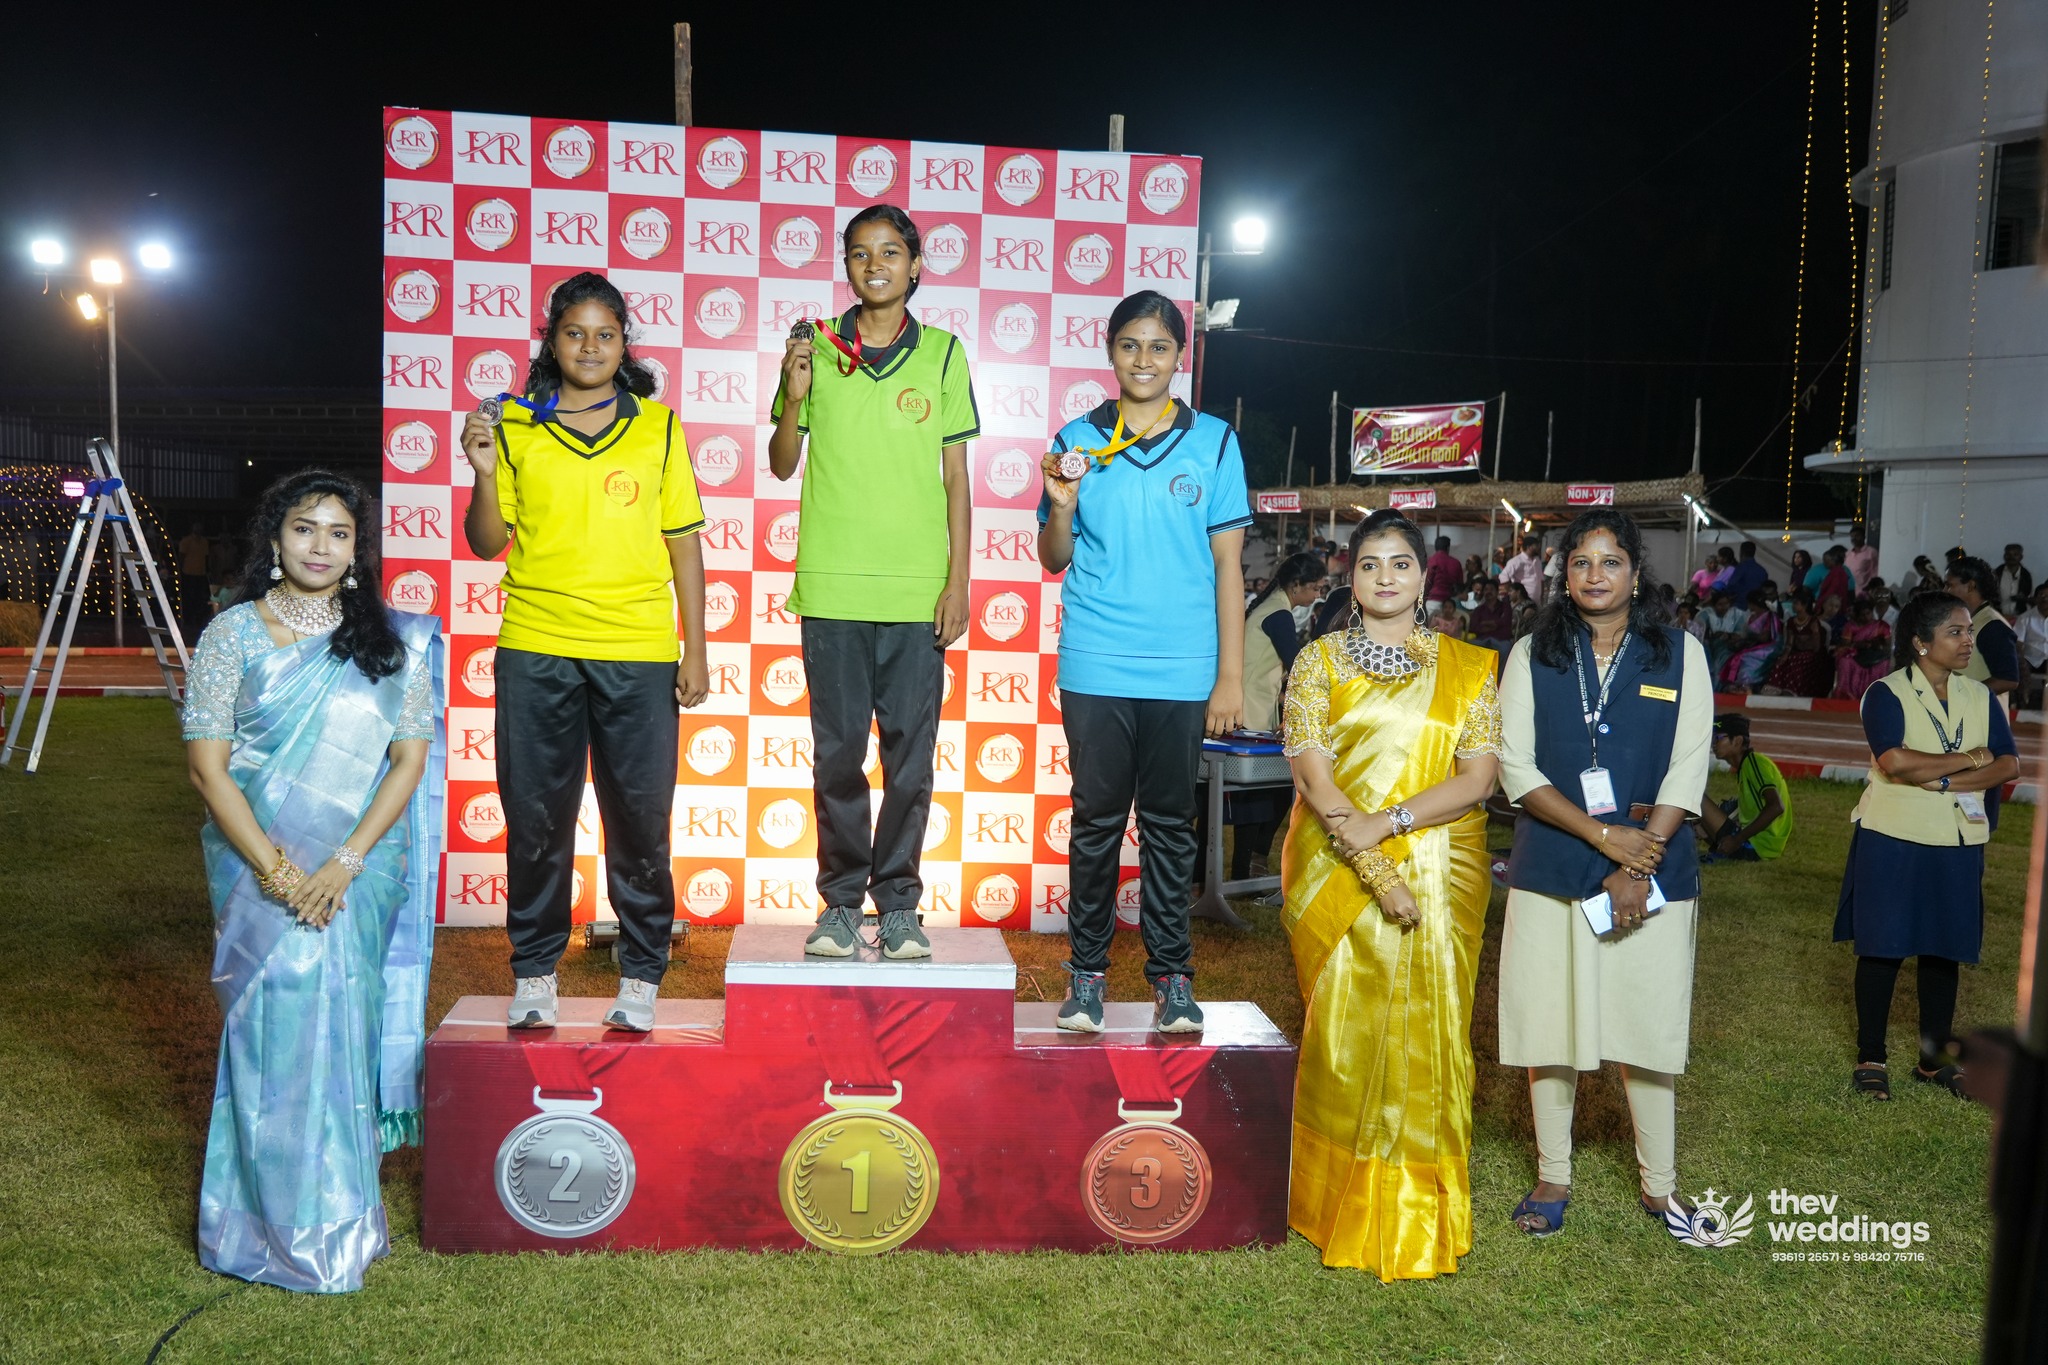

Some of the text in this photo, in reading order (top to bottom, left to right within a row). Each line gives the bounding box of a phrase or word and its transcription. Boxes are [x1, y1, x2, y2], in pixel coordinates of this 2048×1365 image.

[1261, 496, 1299, 508] CASHIER
[548, 1151, 581, 1202] 2
[841, 1151, 870, 1212] 1
[1130, 1157, 1161, 1209] 3
